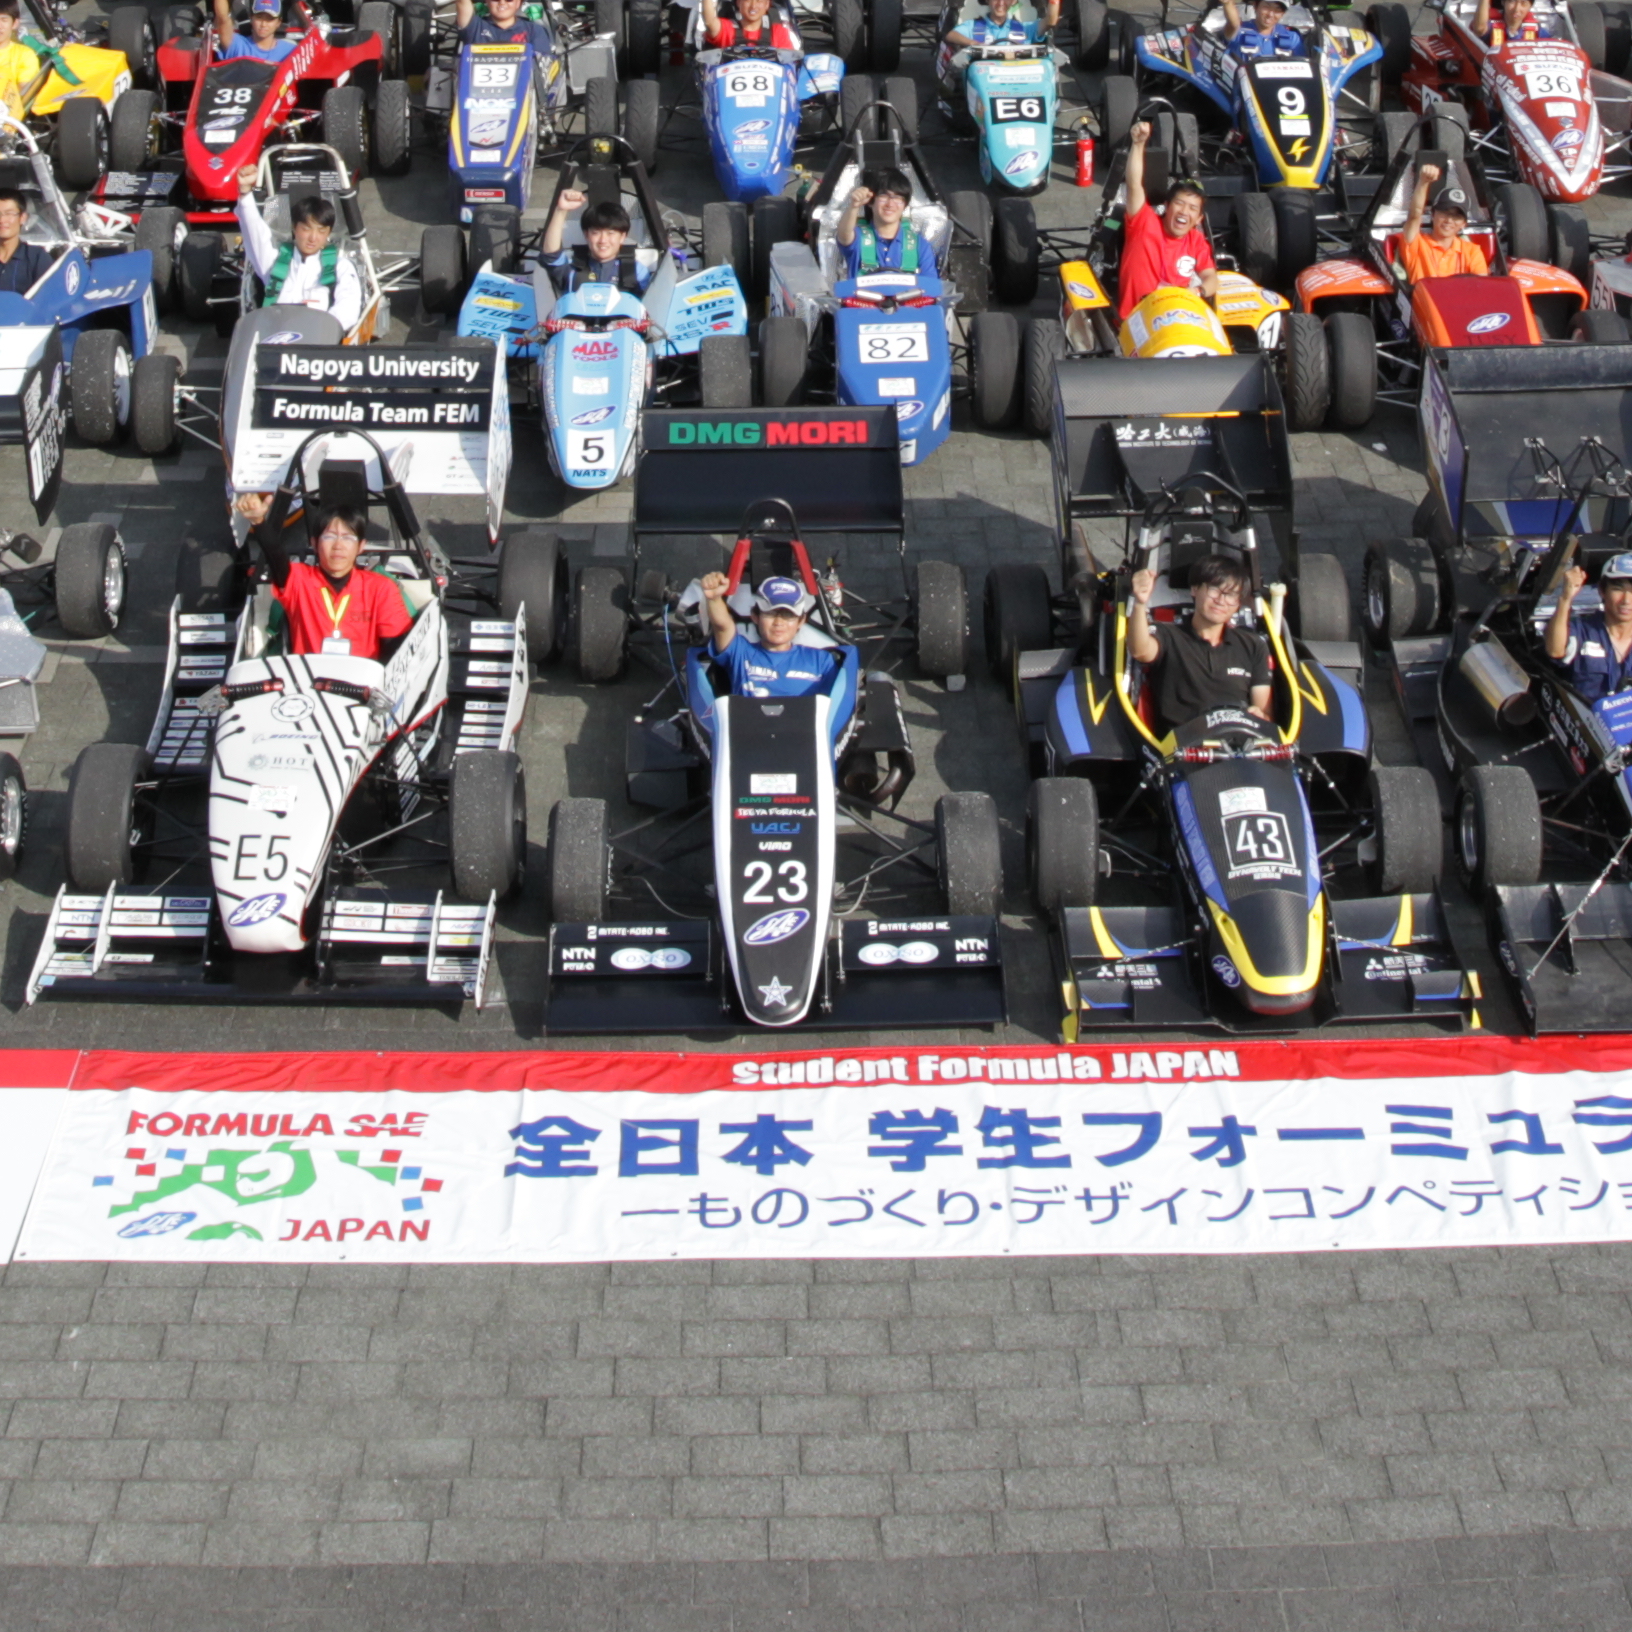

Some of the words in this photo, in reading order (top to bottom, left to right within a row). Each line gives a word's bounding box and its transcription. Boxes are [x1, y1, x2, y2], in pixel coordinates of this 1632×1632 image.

[477, 66, 510, 85] 33
[730, 76, 770, 93] 68
[1536, 72, 1573, 93] 36
[213, 87, 253, 105] 38
[1277, 86, 1305, 118] 9
[994, 98, 1042, 120] E6
[470, 319, 504, 332] SEV
[675, 318, 709, 332] SEV
[571, 340, 619, 356] MAC
[573, 352, 618, 362] TOOLS
[867, 336, 920, 360] 82
[280, 352, 364, 383] Nagoya
[368, 353, 480, 383] University
[273, 397, 365, 422] Formula
[369, 400, 430, 424] Team
[434, 402, 480, 424] FEM
[668, 421, 761, 445] DMG
[768, 420, 868, 445] MORI
[580, 436, 607, 464] 5
[573, 467, 608, 478] NATS
[750, 821, 802, 835] UACJ
[1235, 816, 1286, 861] 43
[232, 834, 292, 882] E5
[742, 860, 810, 904] 23
[71, 912, 96, 923] NTN
[562, 947, 596, 961] NTN
[955, 938, 989, 952] NTN
[918, 1052, 1100, 1082] Formula
[1110, 1048, 1240, 1081] JAPAN
[125, 1111, 335, 1138] FORMULA
[343, 1111, 430, 1138] SAE
[503, 1114, 816, 1178] 全日本
[278, 1218, 431, 1243] JAPAN
